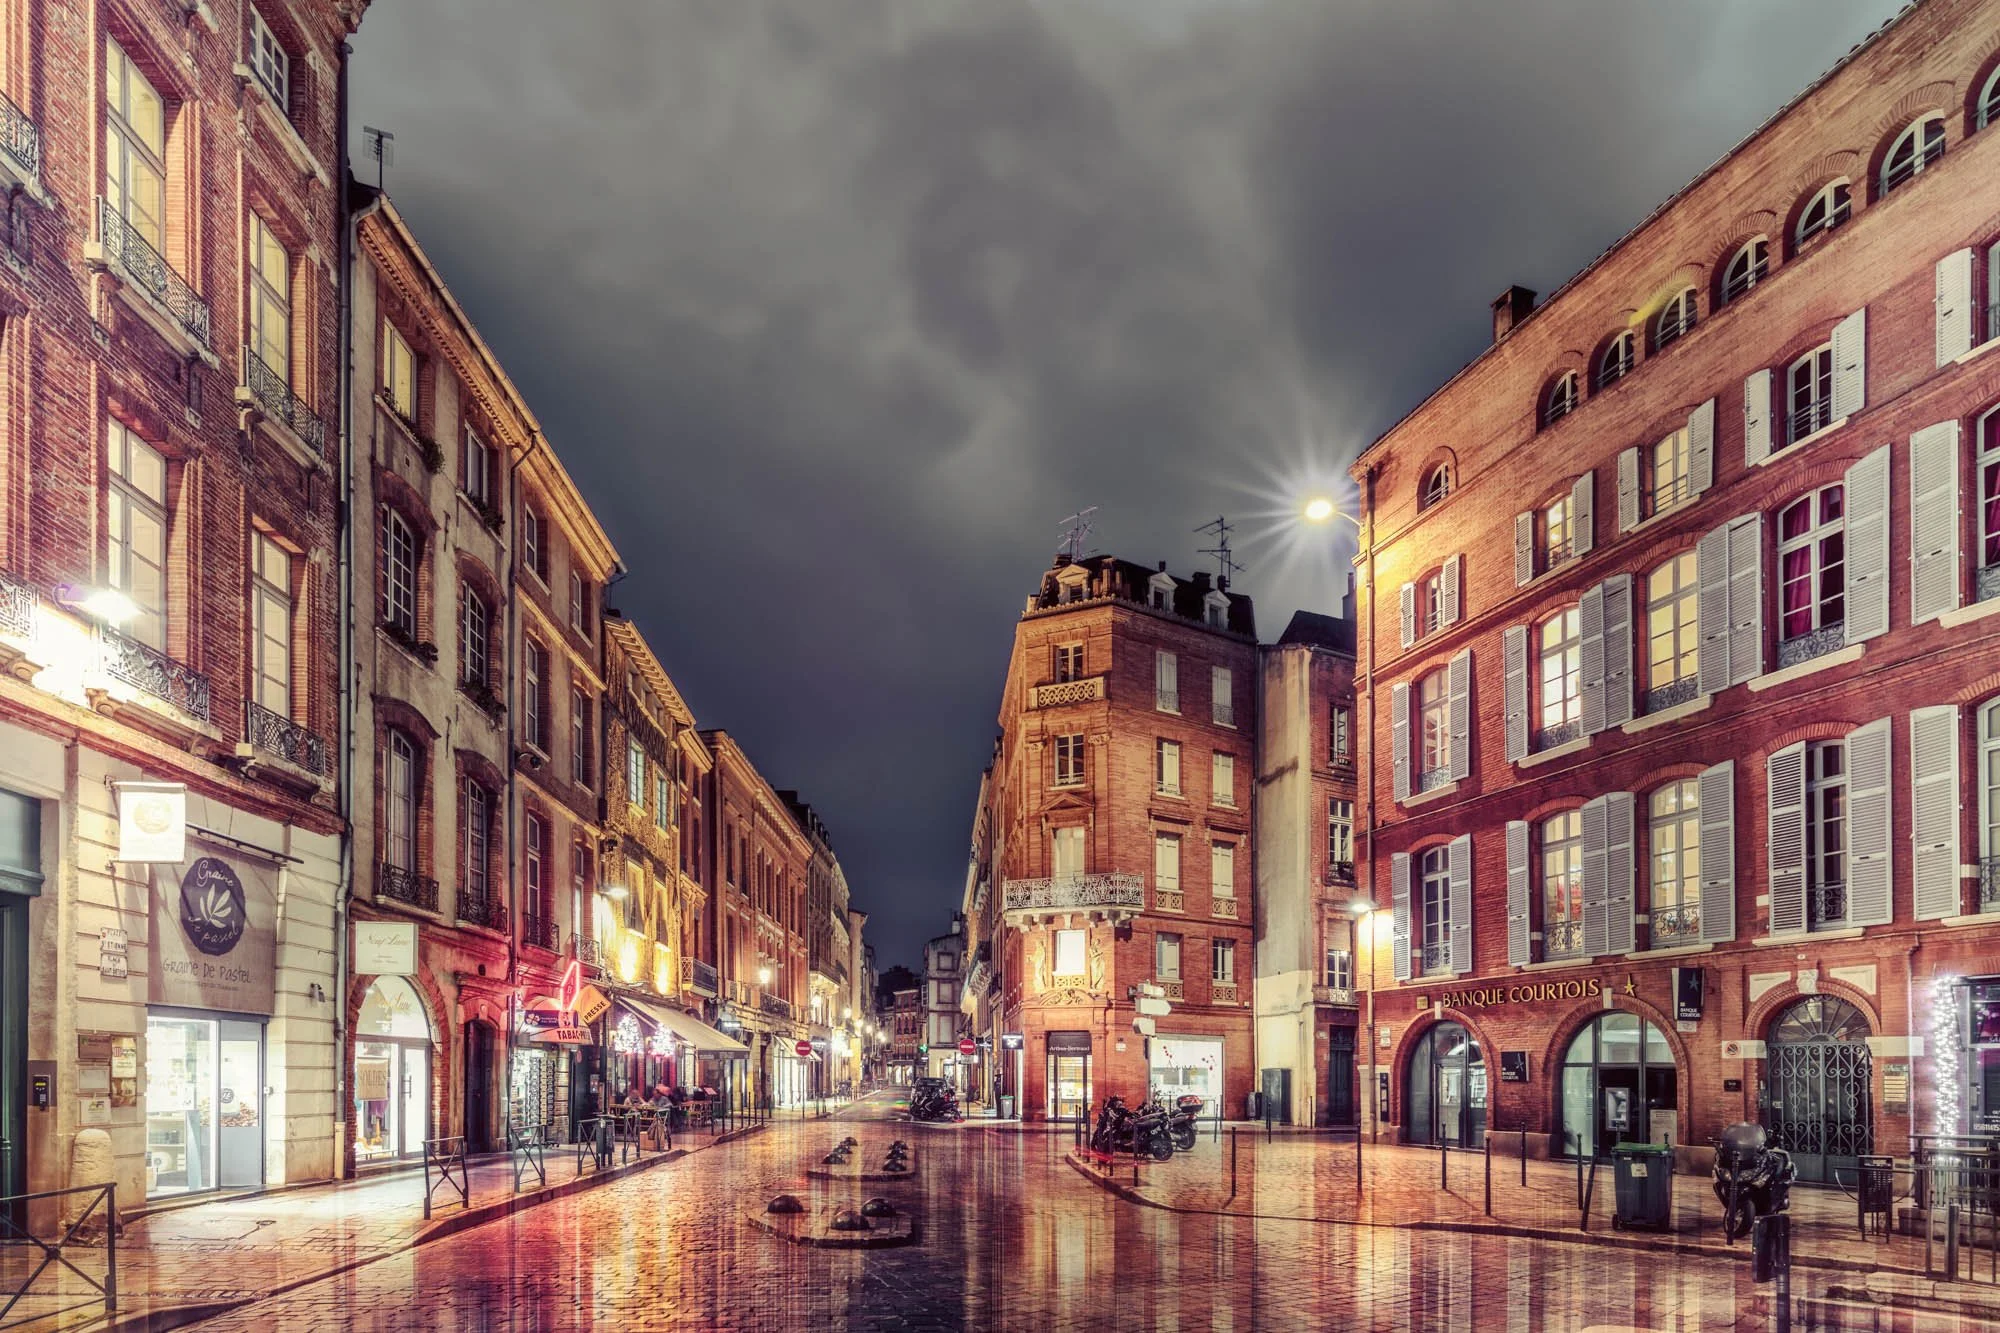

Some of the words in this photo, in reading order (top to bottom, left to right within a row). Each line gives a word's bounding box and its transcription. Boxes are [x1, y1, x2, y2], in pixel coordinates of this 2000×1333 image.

[196, 860, 234, 887] Graine
[1442, 988, 1504, 1008] BANQUE
[1509, 978, 1599, 1003] COURTOIS
[583, 1000, 607, 1021] PRESSE
